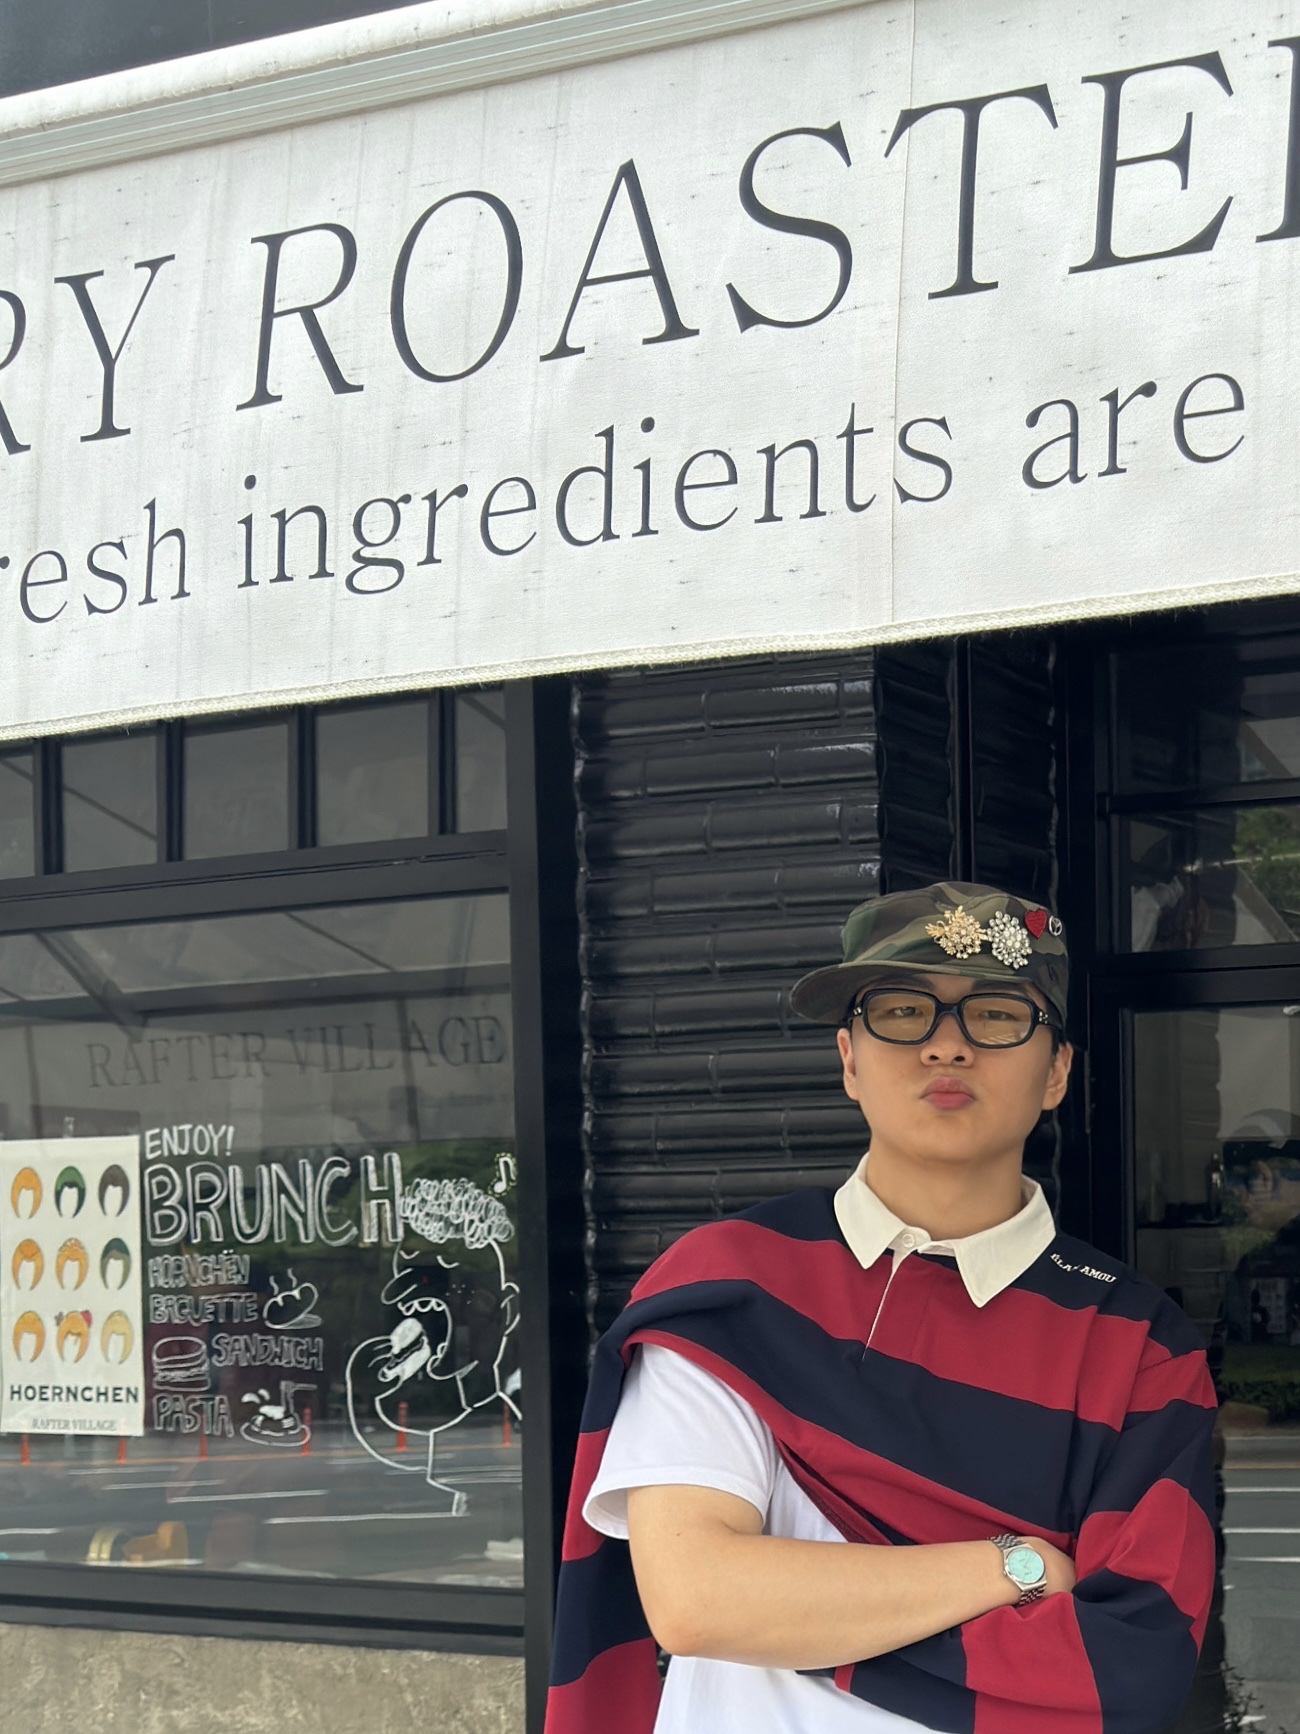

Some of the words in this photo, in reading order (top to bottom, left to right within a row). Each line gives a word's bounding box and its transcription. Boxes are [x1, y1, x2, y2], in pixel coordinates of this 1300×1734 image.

[0, 253, 176, 456] Y
[0, 498, 192, 625] esh
[237, 402, 953, 595] ingredients
[1022, 373, 1245, 489] are
[85, 1031, 271, 1089] RAFTER
[287, 1016, 507, 1074] VILLAGE
[145, 1124, 235, 1160] ENJOY!
[143, 1152, 403, 1247] BRUNCH
[211, 1332, 324, 1372] SANDWICH
[9, 1384, 140, 1404] HOERNCHEN
[152, 1392, 236, 1438] PASTA
